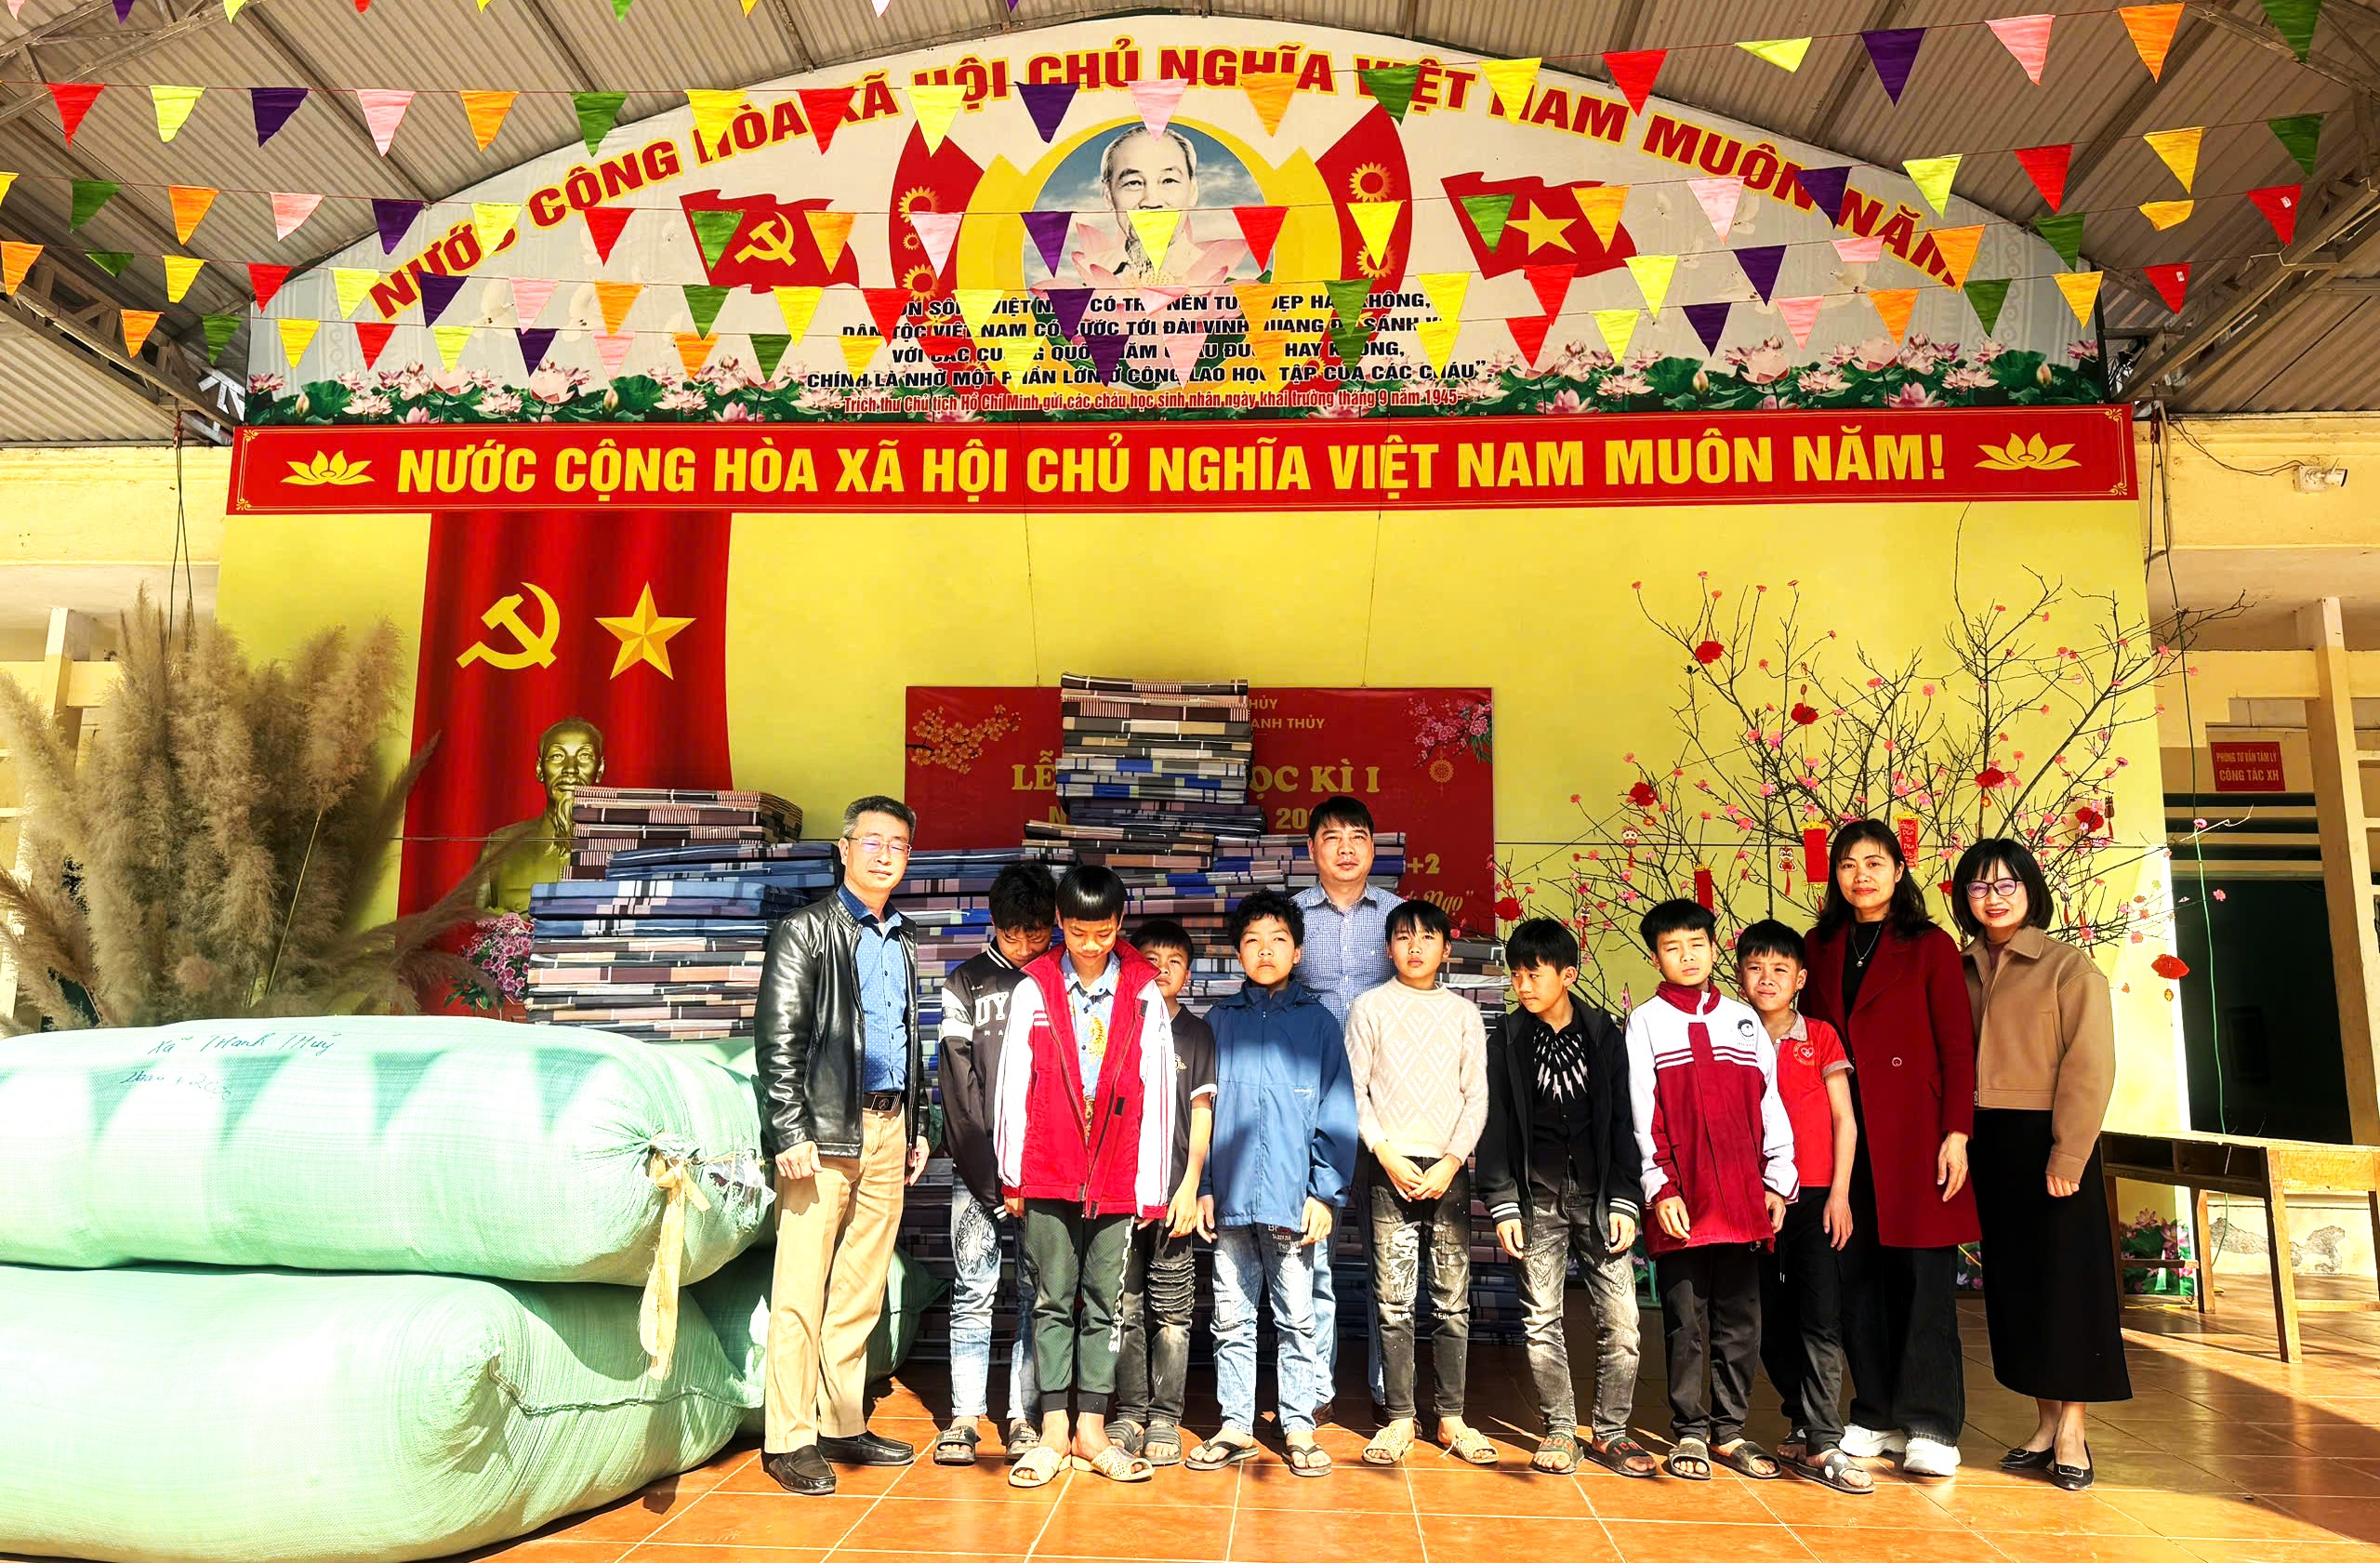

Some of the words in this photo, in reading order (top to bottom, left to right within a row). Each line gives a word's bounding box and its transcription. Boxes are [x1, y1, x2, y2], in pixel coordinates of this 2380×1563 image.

[841, 73, 899, 123] Ã
[1028, 38, 1139, 90] CHỦ
[1160, 45, 1334, 92] NGHĨA
[1643, 114, 1814, 210] MUÔN
[1090, 296, 1117, 311] CÓ
[1123, 298, 1145, 311] TR
[982, 323, 1030, 338] NAM
[1034, 320, 1060, 338] CÓ
[1076, 320, 1119, 336] ƯỚC
[1126, 319, 1157, 335] TỚI
[1163, 318, 1197, 334] ĐÀI
[1202, 320, 1250, 334] VINH
[892, 346, 924, 364] VỚI
[1119, 342, 1157, 359] ĂM
[1285, 342, 1321, 357] HAY
[807, 371, 868, 388] CHÍNH
[876, 370, 899, 387] LÀ
[905, 369, 947, 387] NHỜ
[953, 368, 996, 389] MỘT
[1189, 366, 1225, 382] LAO
[1279, 364, 1317, 385] TẬP
[1371, 361, 1412, 380] CÁC
[880, 396, 902, 412] thư
[904, 394, 928, 412] Chủ
[932, 395, 957, 415] tịch
[961, 393, 977, 411] Hồ
[1007, 394, 1039, 410] Minh
[1043, 391, 1064, 411] gửi
[1068, 392, 1091, 409] các
[1094, 392, 1126, 410] cháu
[1130, 391, 1154, 412] học
[1158, 391, 1184, 407] sinh
[1189, 391, 1221, 407] nhân
[1225, 391, 1256, 410] ngày
[1260, 390, 1288, 407] khai
[1338, 389, 1377, 408] tháng
[1379, 389, 1389, 406] 9
[1391, 389, 1421, 406] năm
[397, 439, 537, 493] NƯỚC
[554, 438, 695, 501] CỘNG
[714, 436, 818, 493] HÒA
[835, 439, 905, 493] XÃ
[922, 438, 1008, 503] HỘI
[1026, 432, 1130, 493] CHỦ
[1149, 436, 1312, 492] NGHĨA
[1328, 434, 1440, 500] VIỆT
[1458, 440, 1584, 488] NAM
[1605, 428, 1774, 485] MUÔN
[1792, 424, 1945, 483] NĂM!
[1250, 695, 1278, 709] HỦY
[1251, 718, 1282, 729] ANH
[1287, 714, 1325, 729] THỦY
[1011, 749, 1057, 790] LỄ
[1250, 765, 1299, 800] ỌC
[1310, 758, 1355, 793] KÌ
[1365, 765, 1381, 792] I
[2219, 767, 2245, 781] CÔNG
[2245, 767, 2265, 781] TÁC
[2266, 769, 2280, 781] XH
